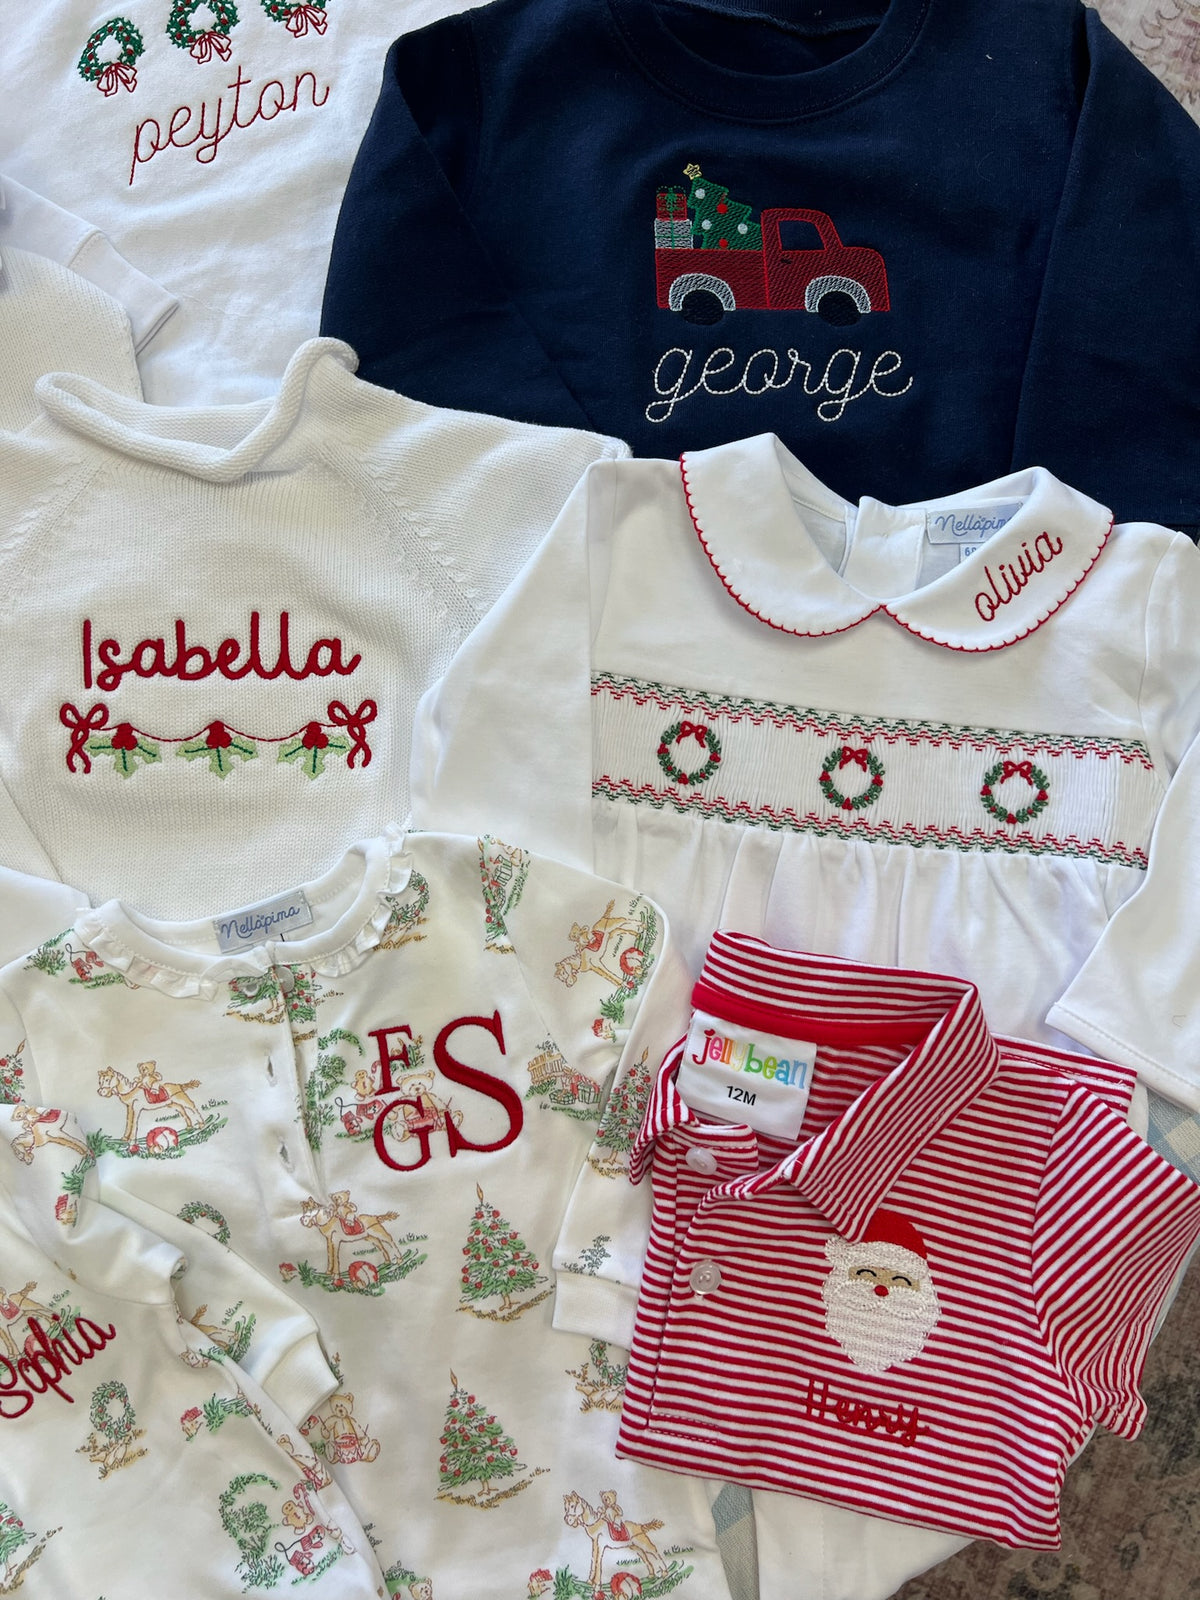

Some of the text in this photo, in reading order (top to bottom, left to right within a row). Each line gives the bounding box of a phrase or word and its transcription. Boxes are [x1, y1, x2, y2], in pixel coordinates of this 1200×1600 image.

[128, 65, 330, 187] peyton
[644, 346, 913, 423] george
[974, 530, 1063, 622] olivia
[82, 610, 362, 692] Isabella
[692, 1028, 808, 1090] jellybean
[726, 1085, 757, 1106] 12M
[805, 1377, 930, 1447] Henry
